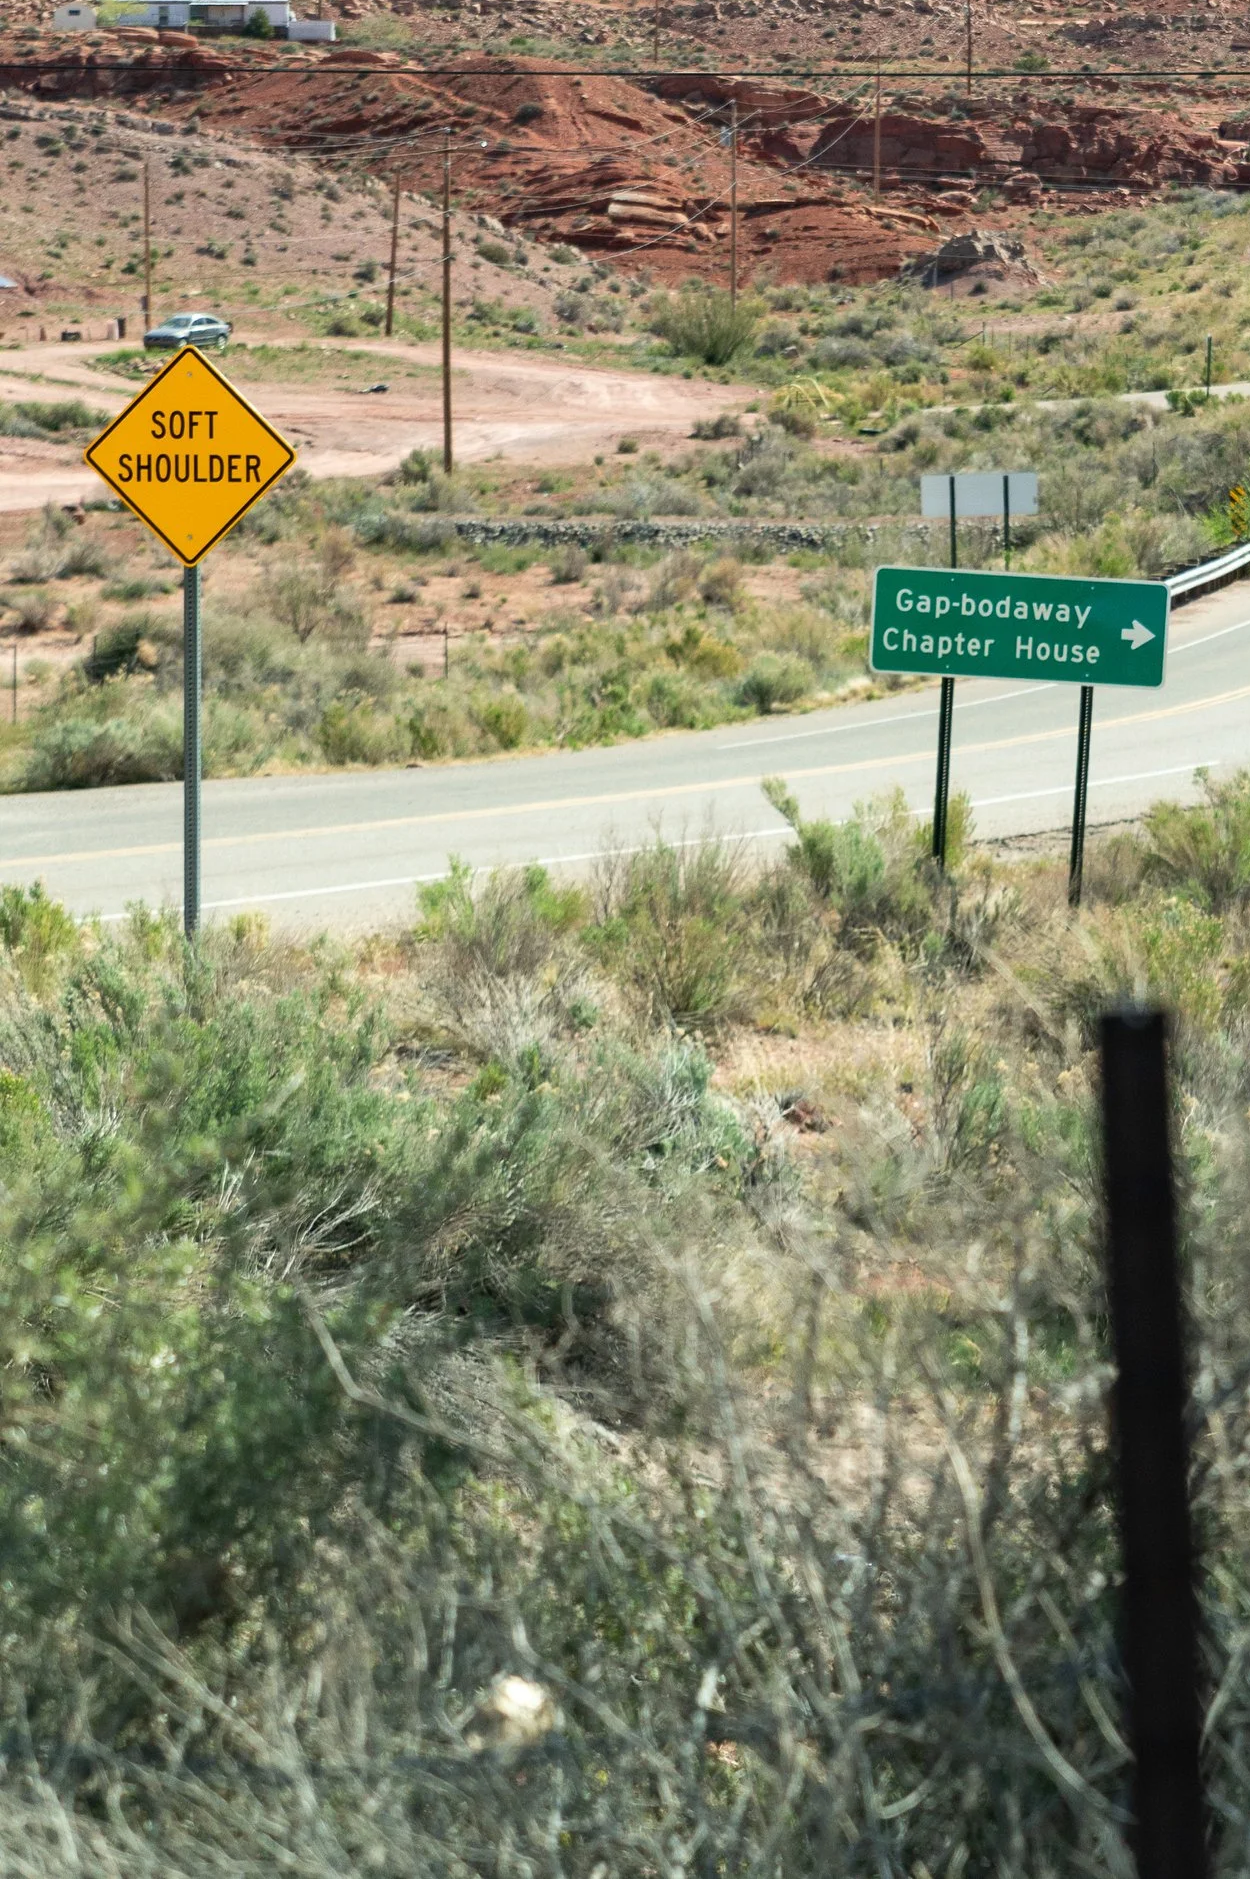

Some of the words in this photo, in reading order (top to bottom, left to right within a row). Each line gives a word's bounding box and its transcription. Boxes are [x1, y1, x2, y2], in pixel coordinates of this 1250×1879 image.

[151, 410, 218, 439] SOFT
[118, 453, 261, 483] SHOULDER
[896, 588, 1092, 629] Gap-bodaway
[882, 627, 995, 658] Chapter
[1015, 635, 1101, 664] House
